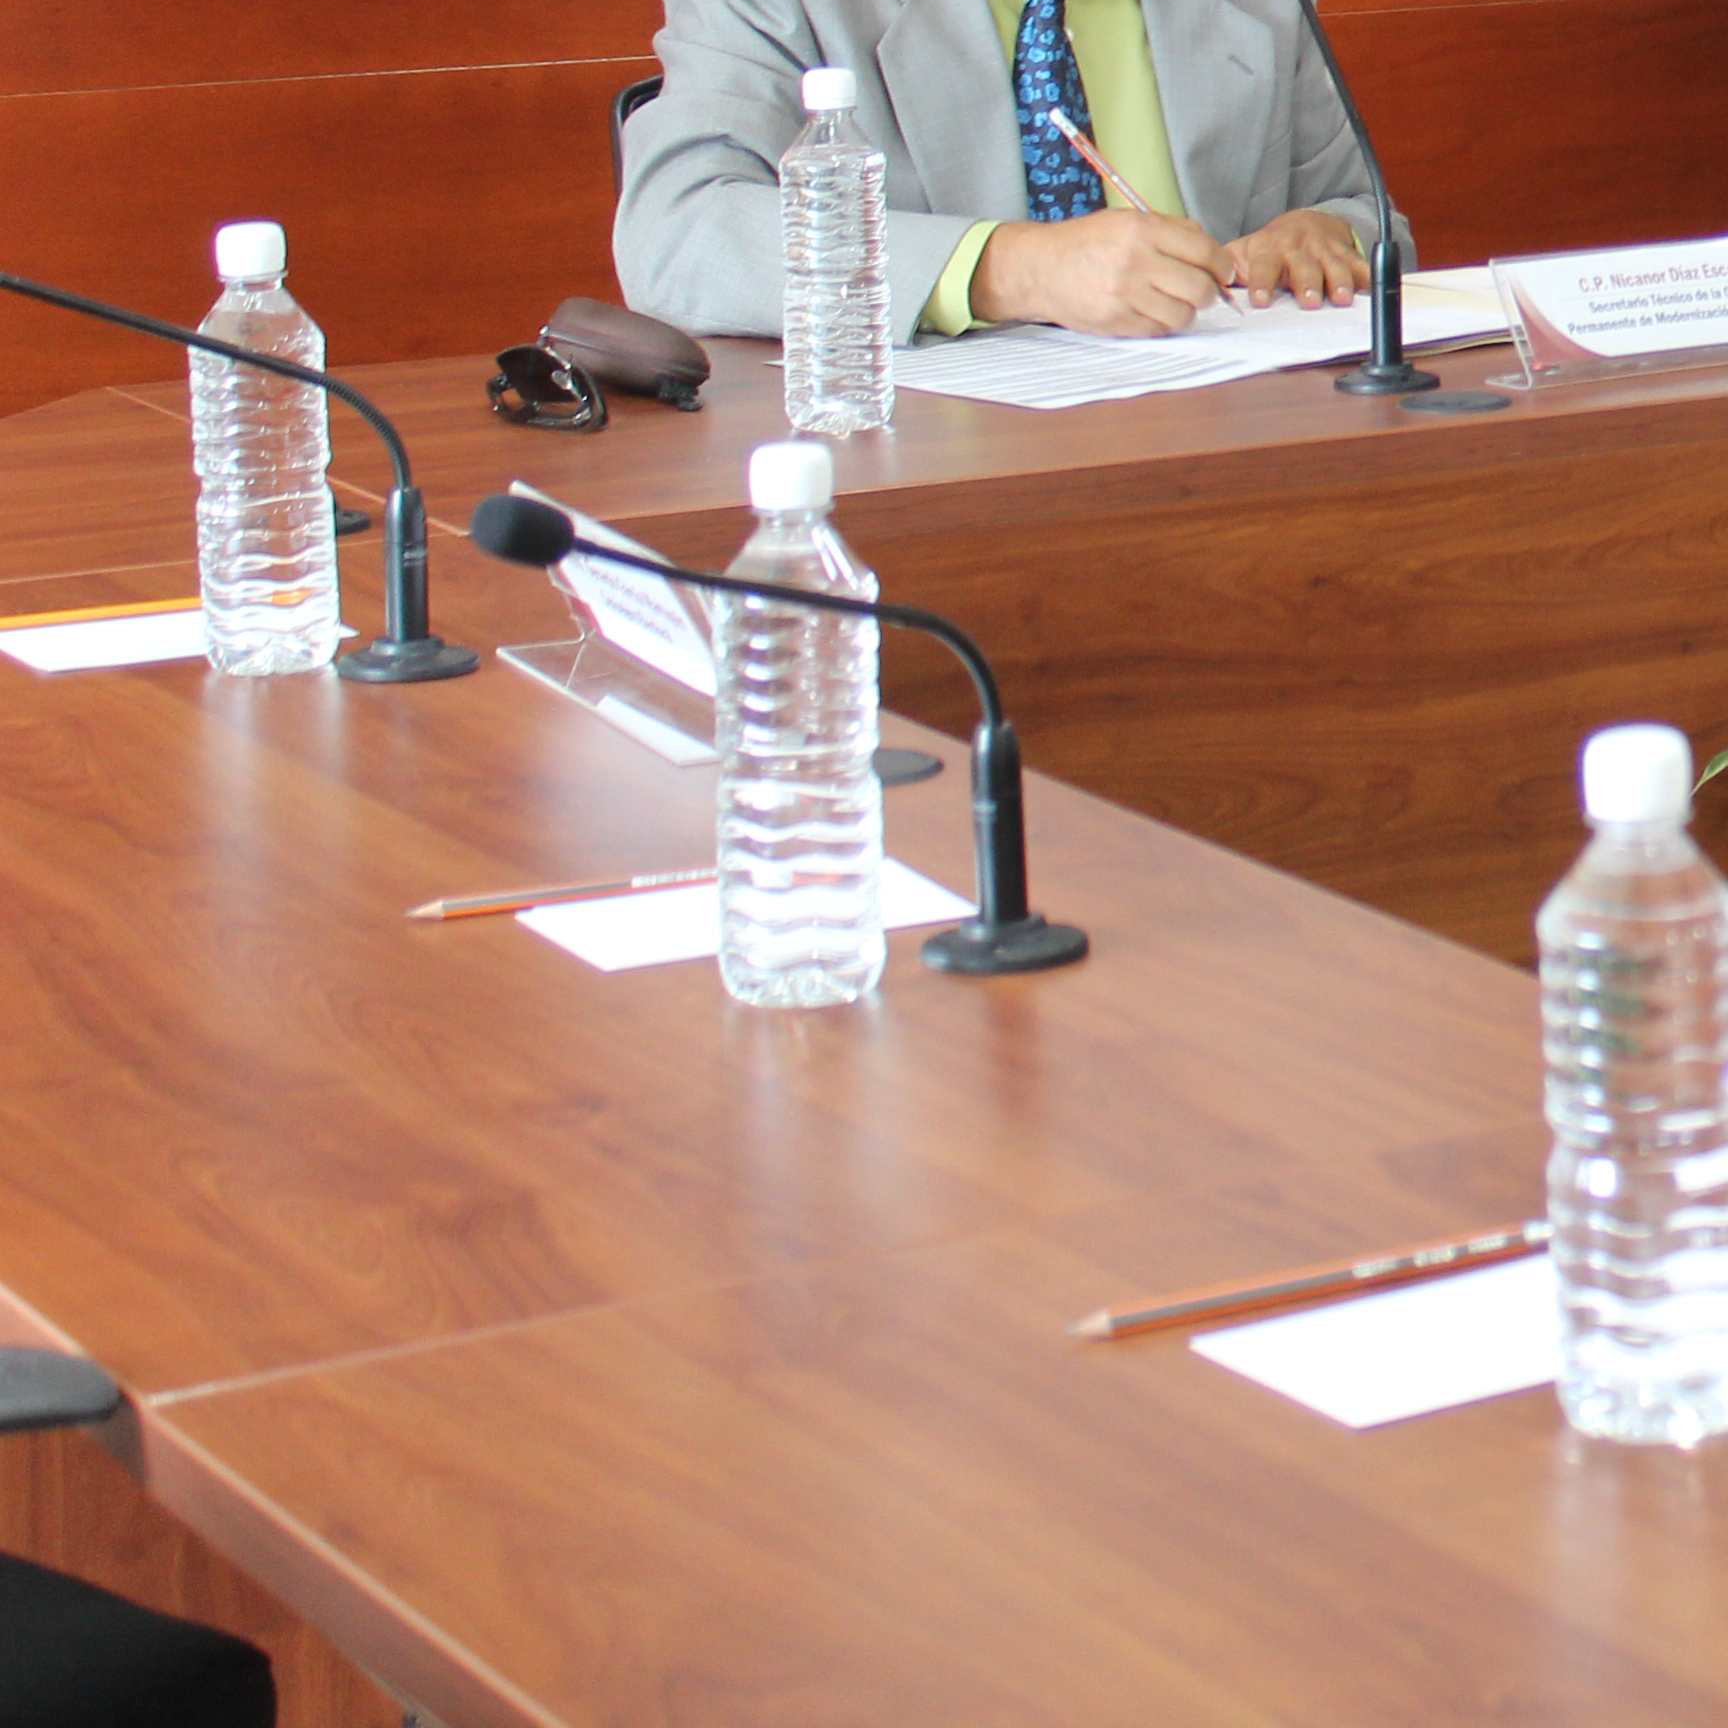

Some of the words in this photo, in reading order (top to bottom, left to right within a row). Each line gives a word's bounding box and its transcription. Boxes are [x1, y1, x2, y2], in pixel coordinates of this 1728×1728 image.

[1578, 275, 1608, 293] C.P.
[1610, 269, 1667, 290] Nicanor
[1669, 264, 1700, 283] Díaz
[1588, 295, 1650, 314] Secretario
[1651, 288, 1694, 306] Técnico
[1695, 287, 1710, 302] de
[1711, 286, 1721, 299] la
[1567, 316, 1637, 335] Permanente
[1638, 313, 1653, 327] de
